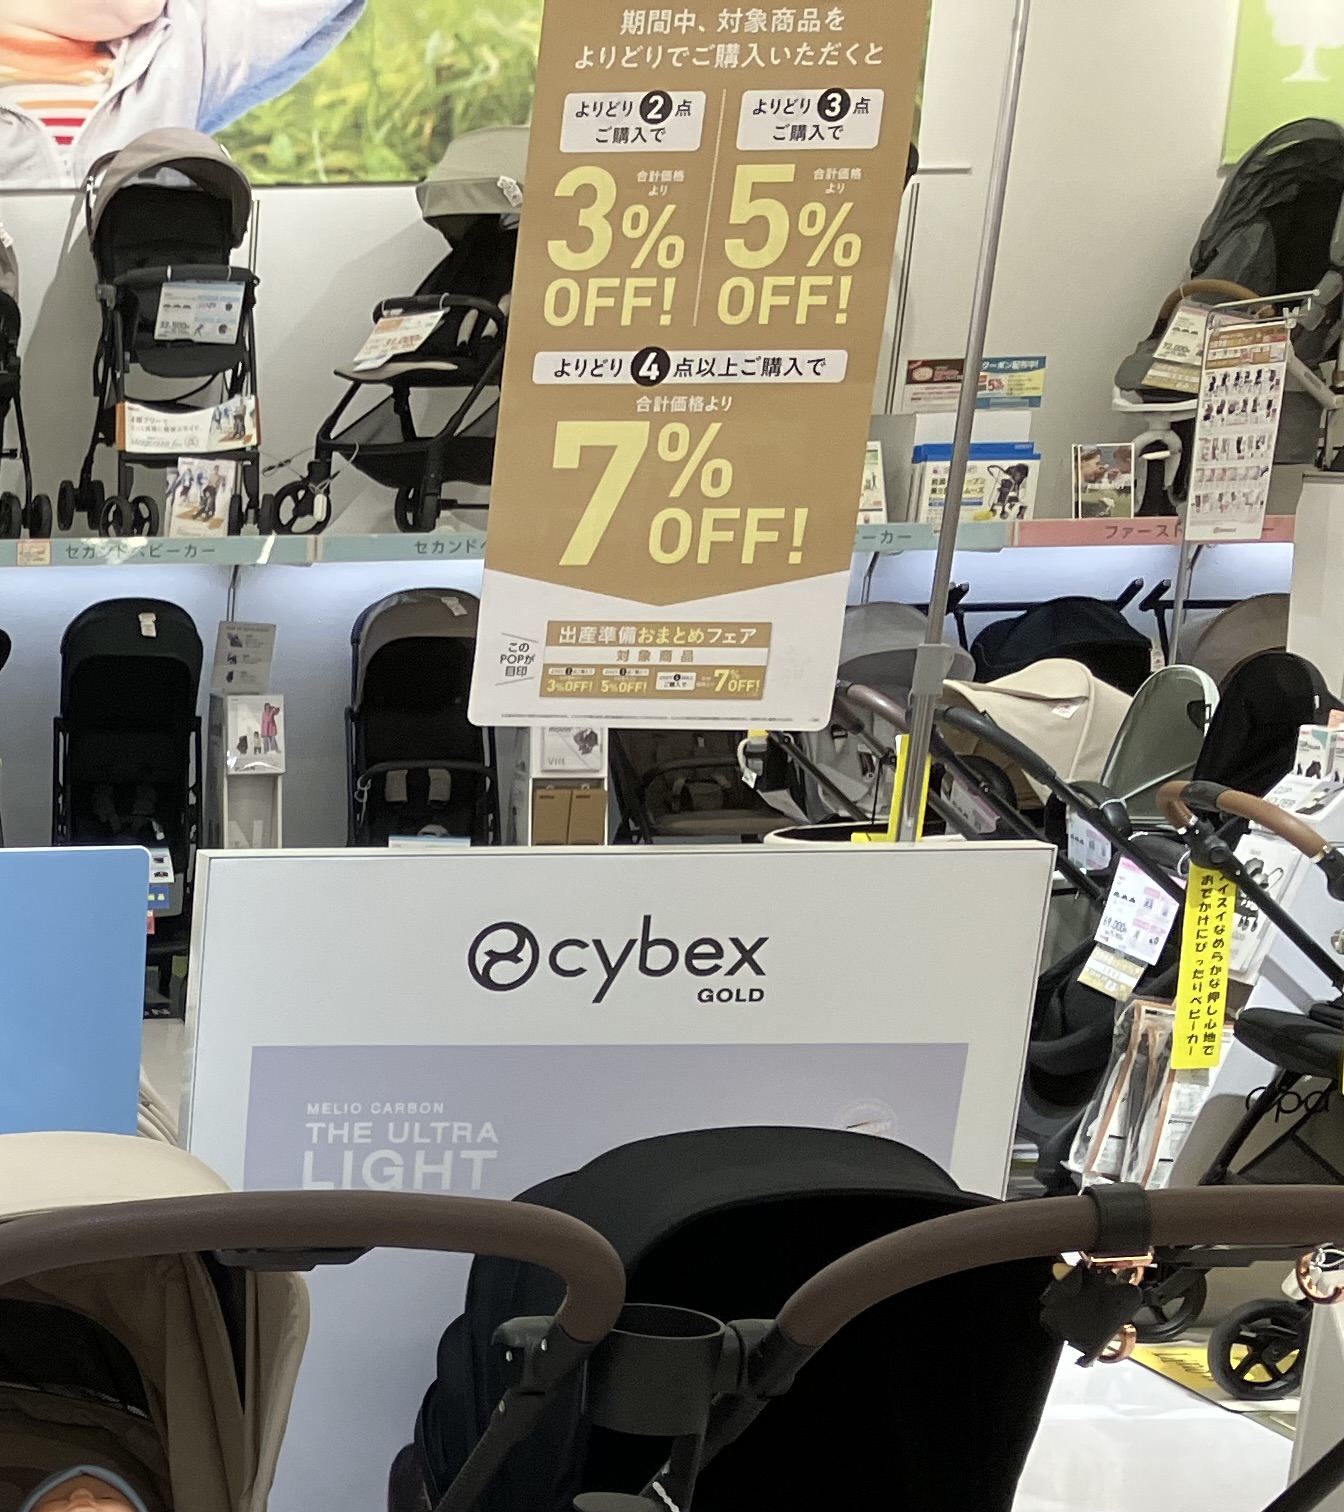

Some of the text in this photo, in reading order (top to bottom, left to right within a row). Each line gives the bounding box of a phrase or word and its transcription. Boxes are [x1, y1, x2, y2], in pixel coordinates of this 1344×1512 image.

[620, 8, 845, 35] 期間中、対象商品を
[575, 42, 884, 70] よりどりでご購入いただくと
[595, 126, 665, 144] ご購入で
[772, 123, 844, 142] ご購入で
[637, 170, 684, 183] 合計価格
[813, 168, 862, 181] 合計価格
[648, 184, 669, 196] より
[824, 182, 845, 195] より
[543, 276, 677, 327] OFF!
[716, 275, 853, 325] OFF!
[636, 395, 733, 413] 合計価格より
[647, 506, 809, 565] OFF!
[559, 626, 757, 645] 出産準備おまとめフェア
[509, 643, 529, 652] この
[500, 653, 535, 665] POPが
[505, 666, 528, 676] 目印
[547, 914, 770, 1004] cybex
[697, 987, 765, 1004] GOLD
[307, 1101, 445, 1115] MELIO CARBON
[305, 1120, 500, 1144] THE ULTRA
[301, 1148, 500, 1191] LIGHT
